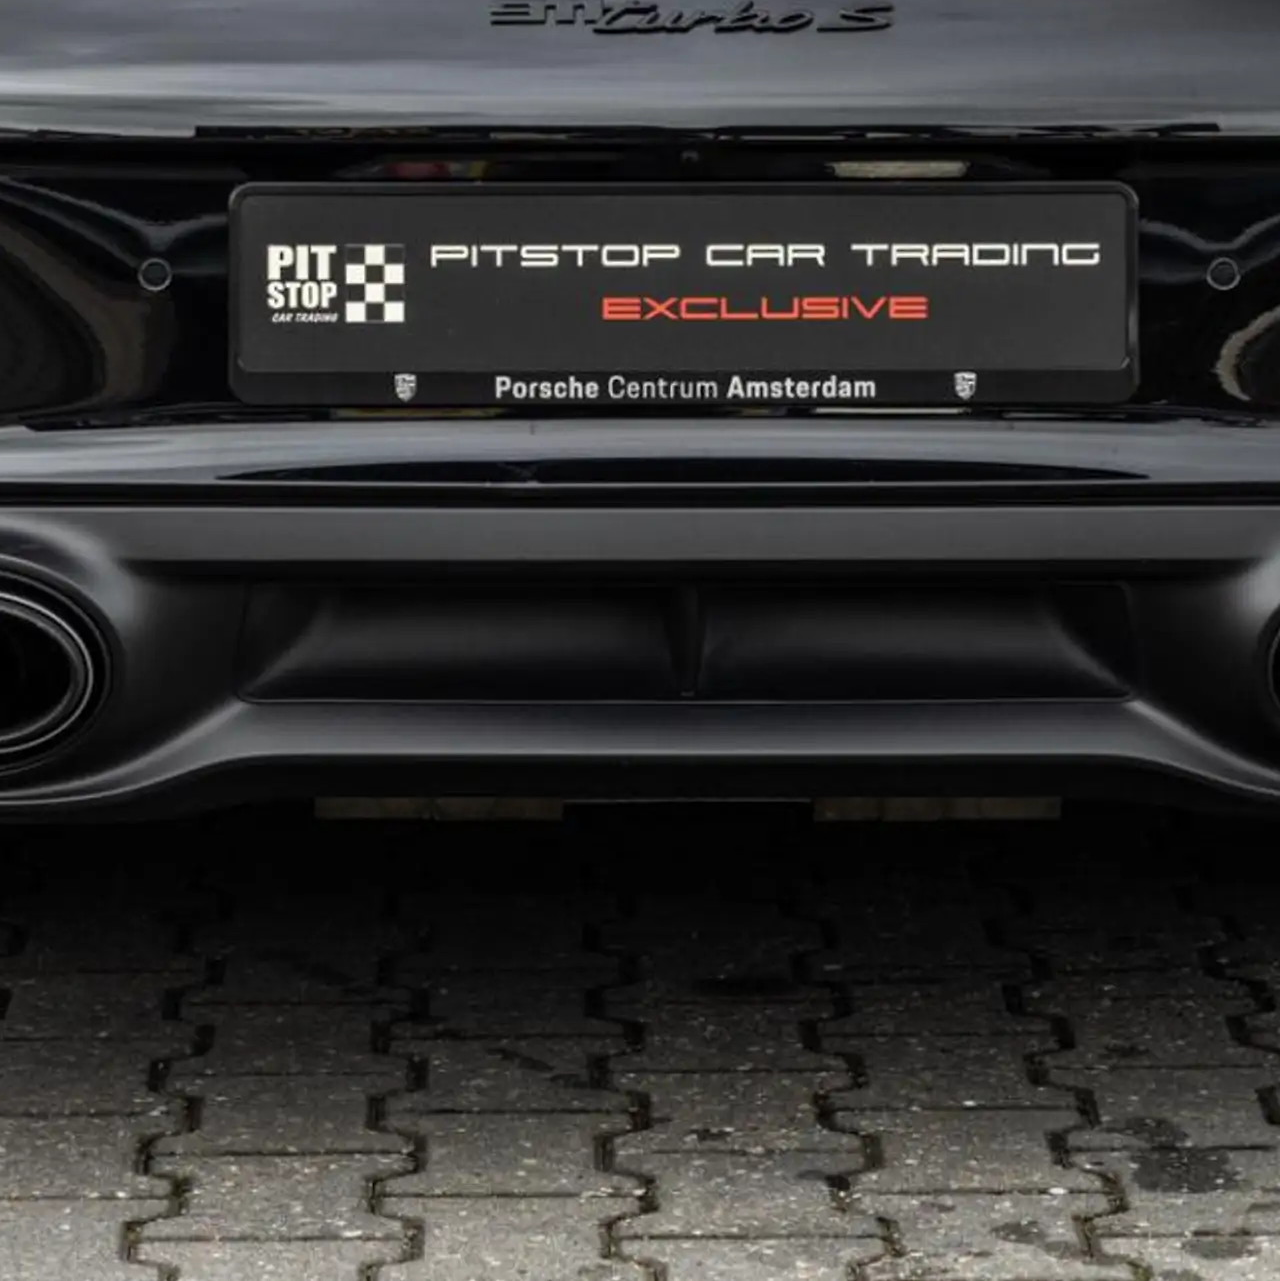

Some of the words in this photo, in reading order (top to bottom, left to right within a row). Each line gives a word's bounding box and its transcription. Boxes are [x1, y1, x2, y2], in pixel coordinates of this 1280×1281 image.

[817, 3, 895, 33] S
[267, 244, 338, 280] PIT
[430, 244, 681, 268] PITSTOP
[705, 243, 826, 267] CAR
[850, 242, 1101, 267] TRADING
[267, 281, 338, 309] STOP
[601, 295, 928, 321] EXCLUSIVE
[495, 375, 599, 399] Porsche
[608, 375, 718, 399] Centrum
[726, 374, 876, 399] Amsterdam
